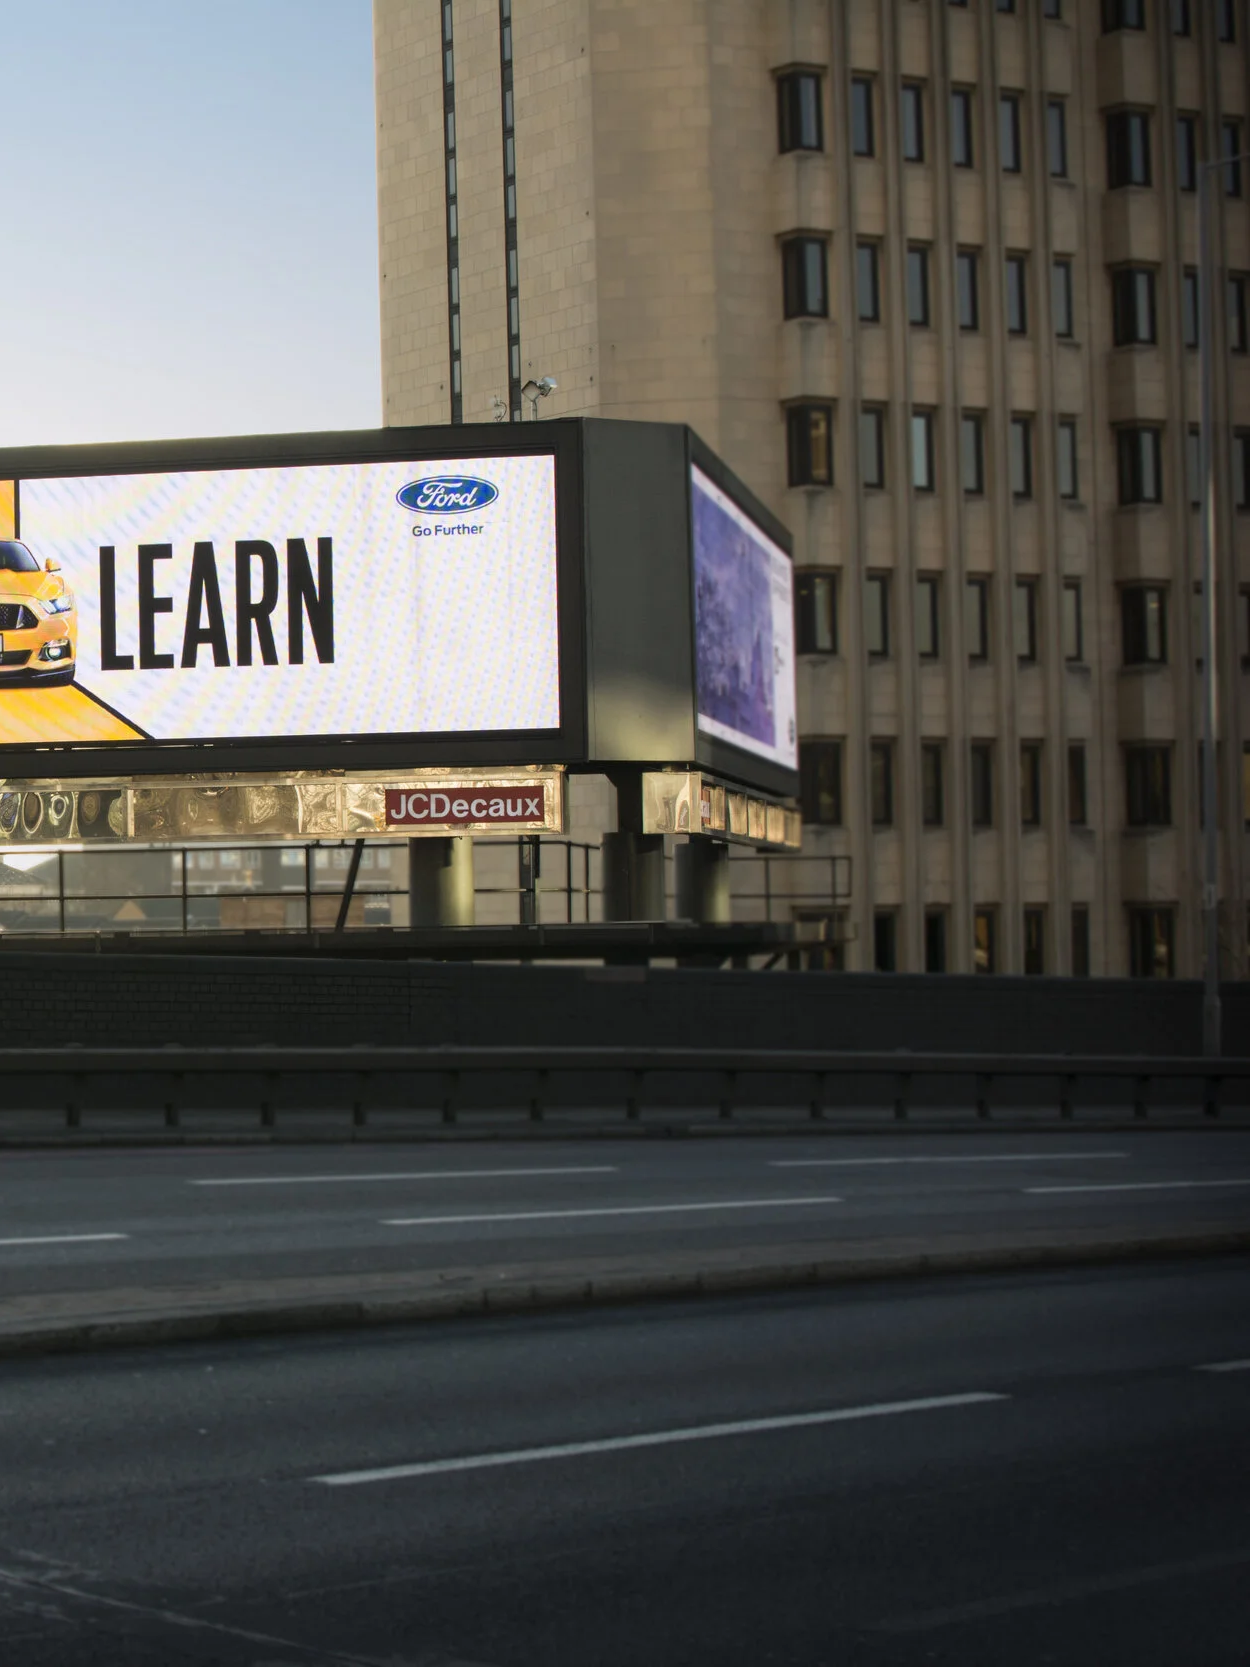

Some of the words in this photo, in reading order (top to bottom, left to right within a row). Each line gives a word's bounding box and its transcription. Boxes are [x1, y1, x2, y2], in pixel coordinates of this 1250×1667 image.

[416, 481, 479, 508] Ford
[412, 525, 432, 537] Go
[435, 523, 484, 536] Further
[99, 536, 335, 671] LEARN
[390, 793, 541, 819] JCDecaux
